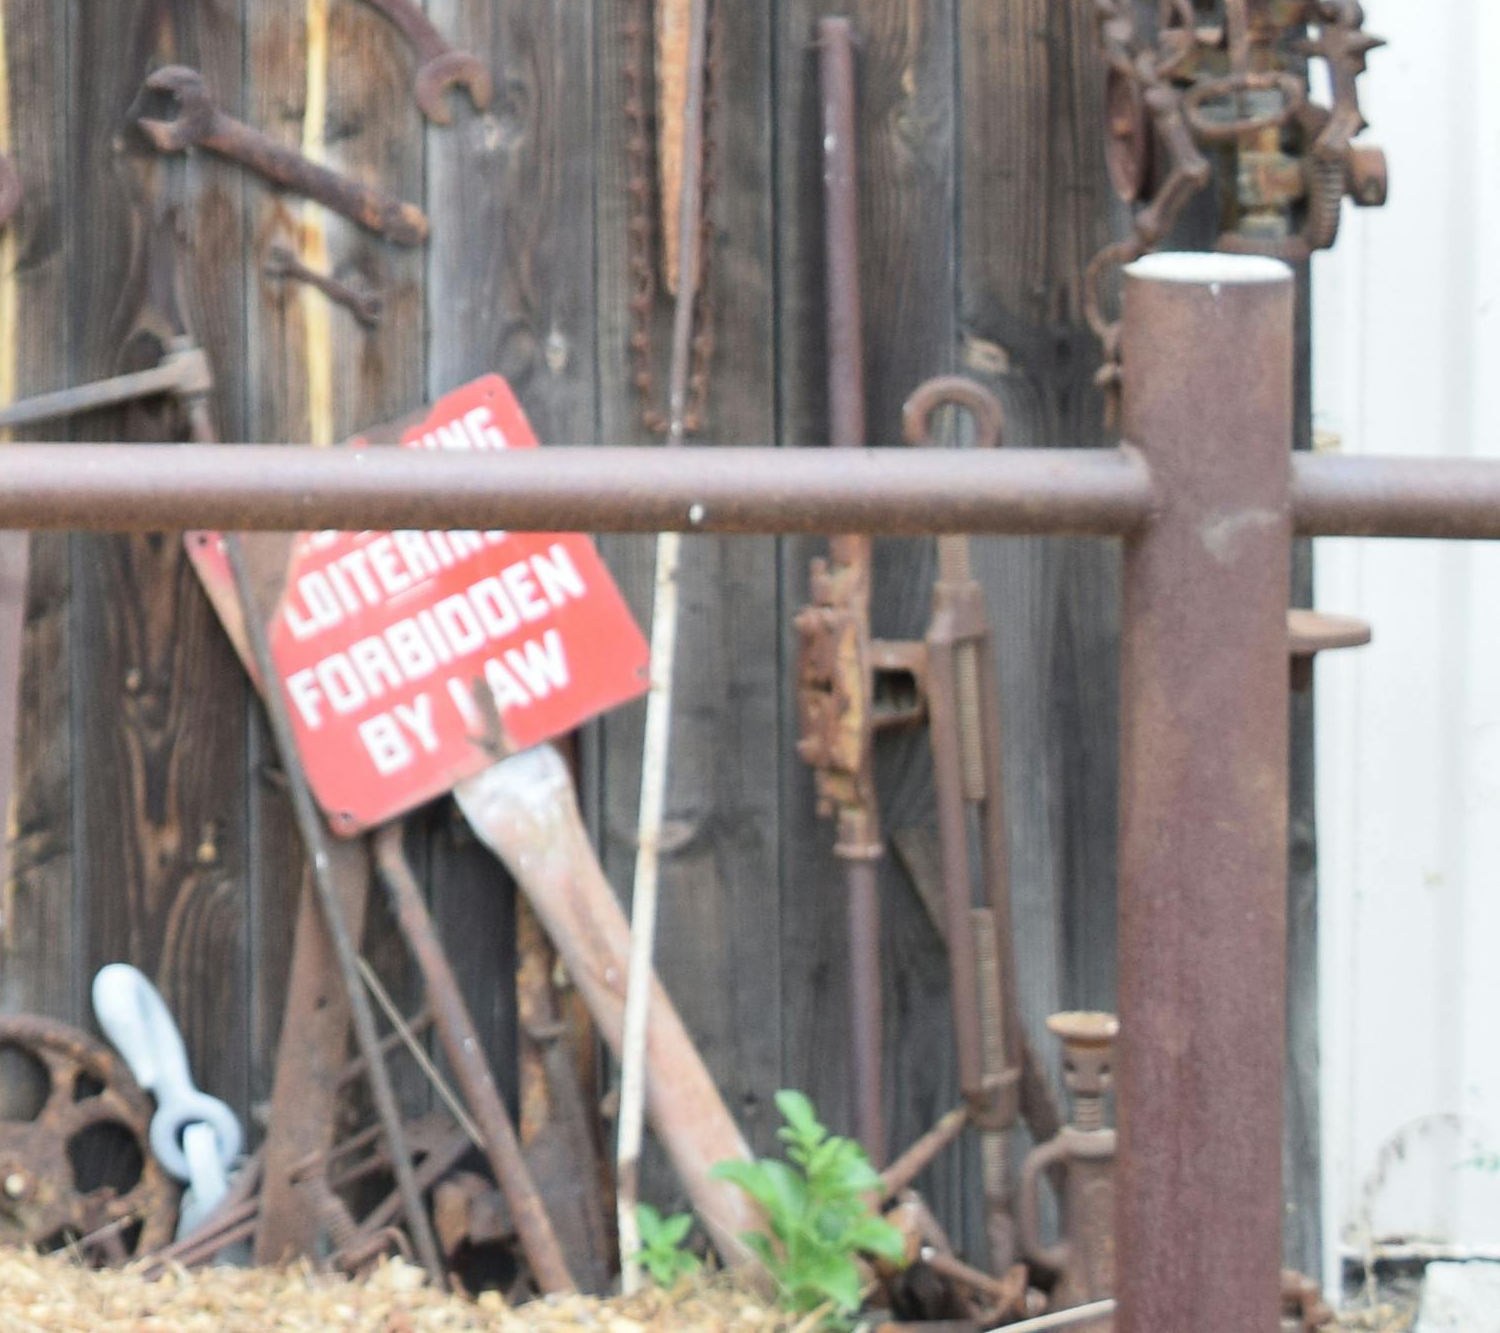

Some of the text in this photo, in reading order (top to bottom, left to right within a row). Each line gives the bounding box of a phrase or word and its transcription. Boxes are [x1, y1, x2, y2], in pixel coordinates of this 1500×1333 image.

[284, 530, 505, 642] LOITERIN
[286, 543, 586, 729] FORBIDDEN
[358, 693, 439, 776] BY
